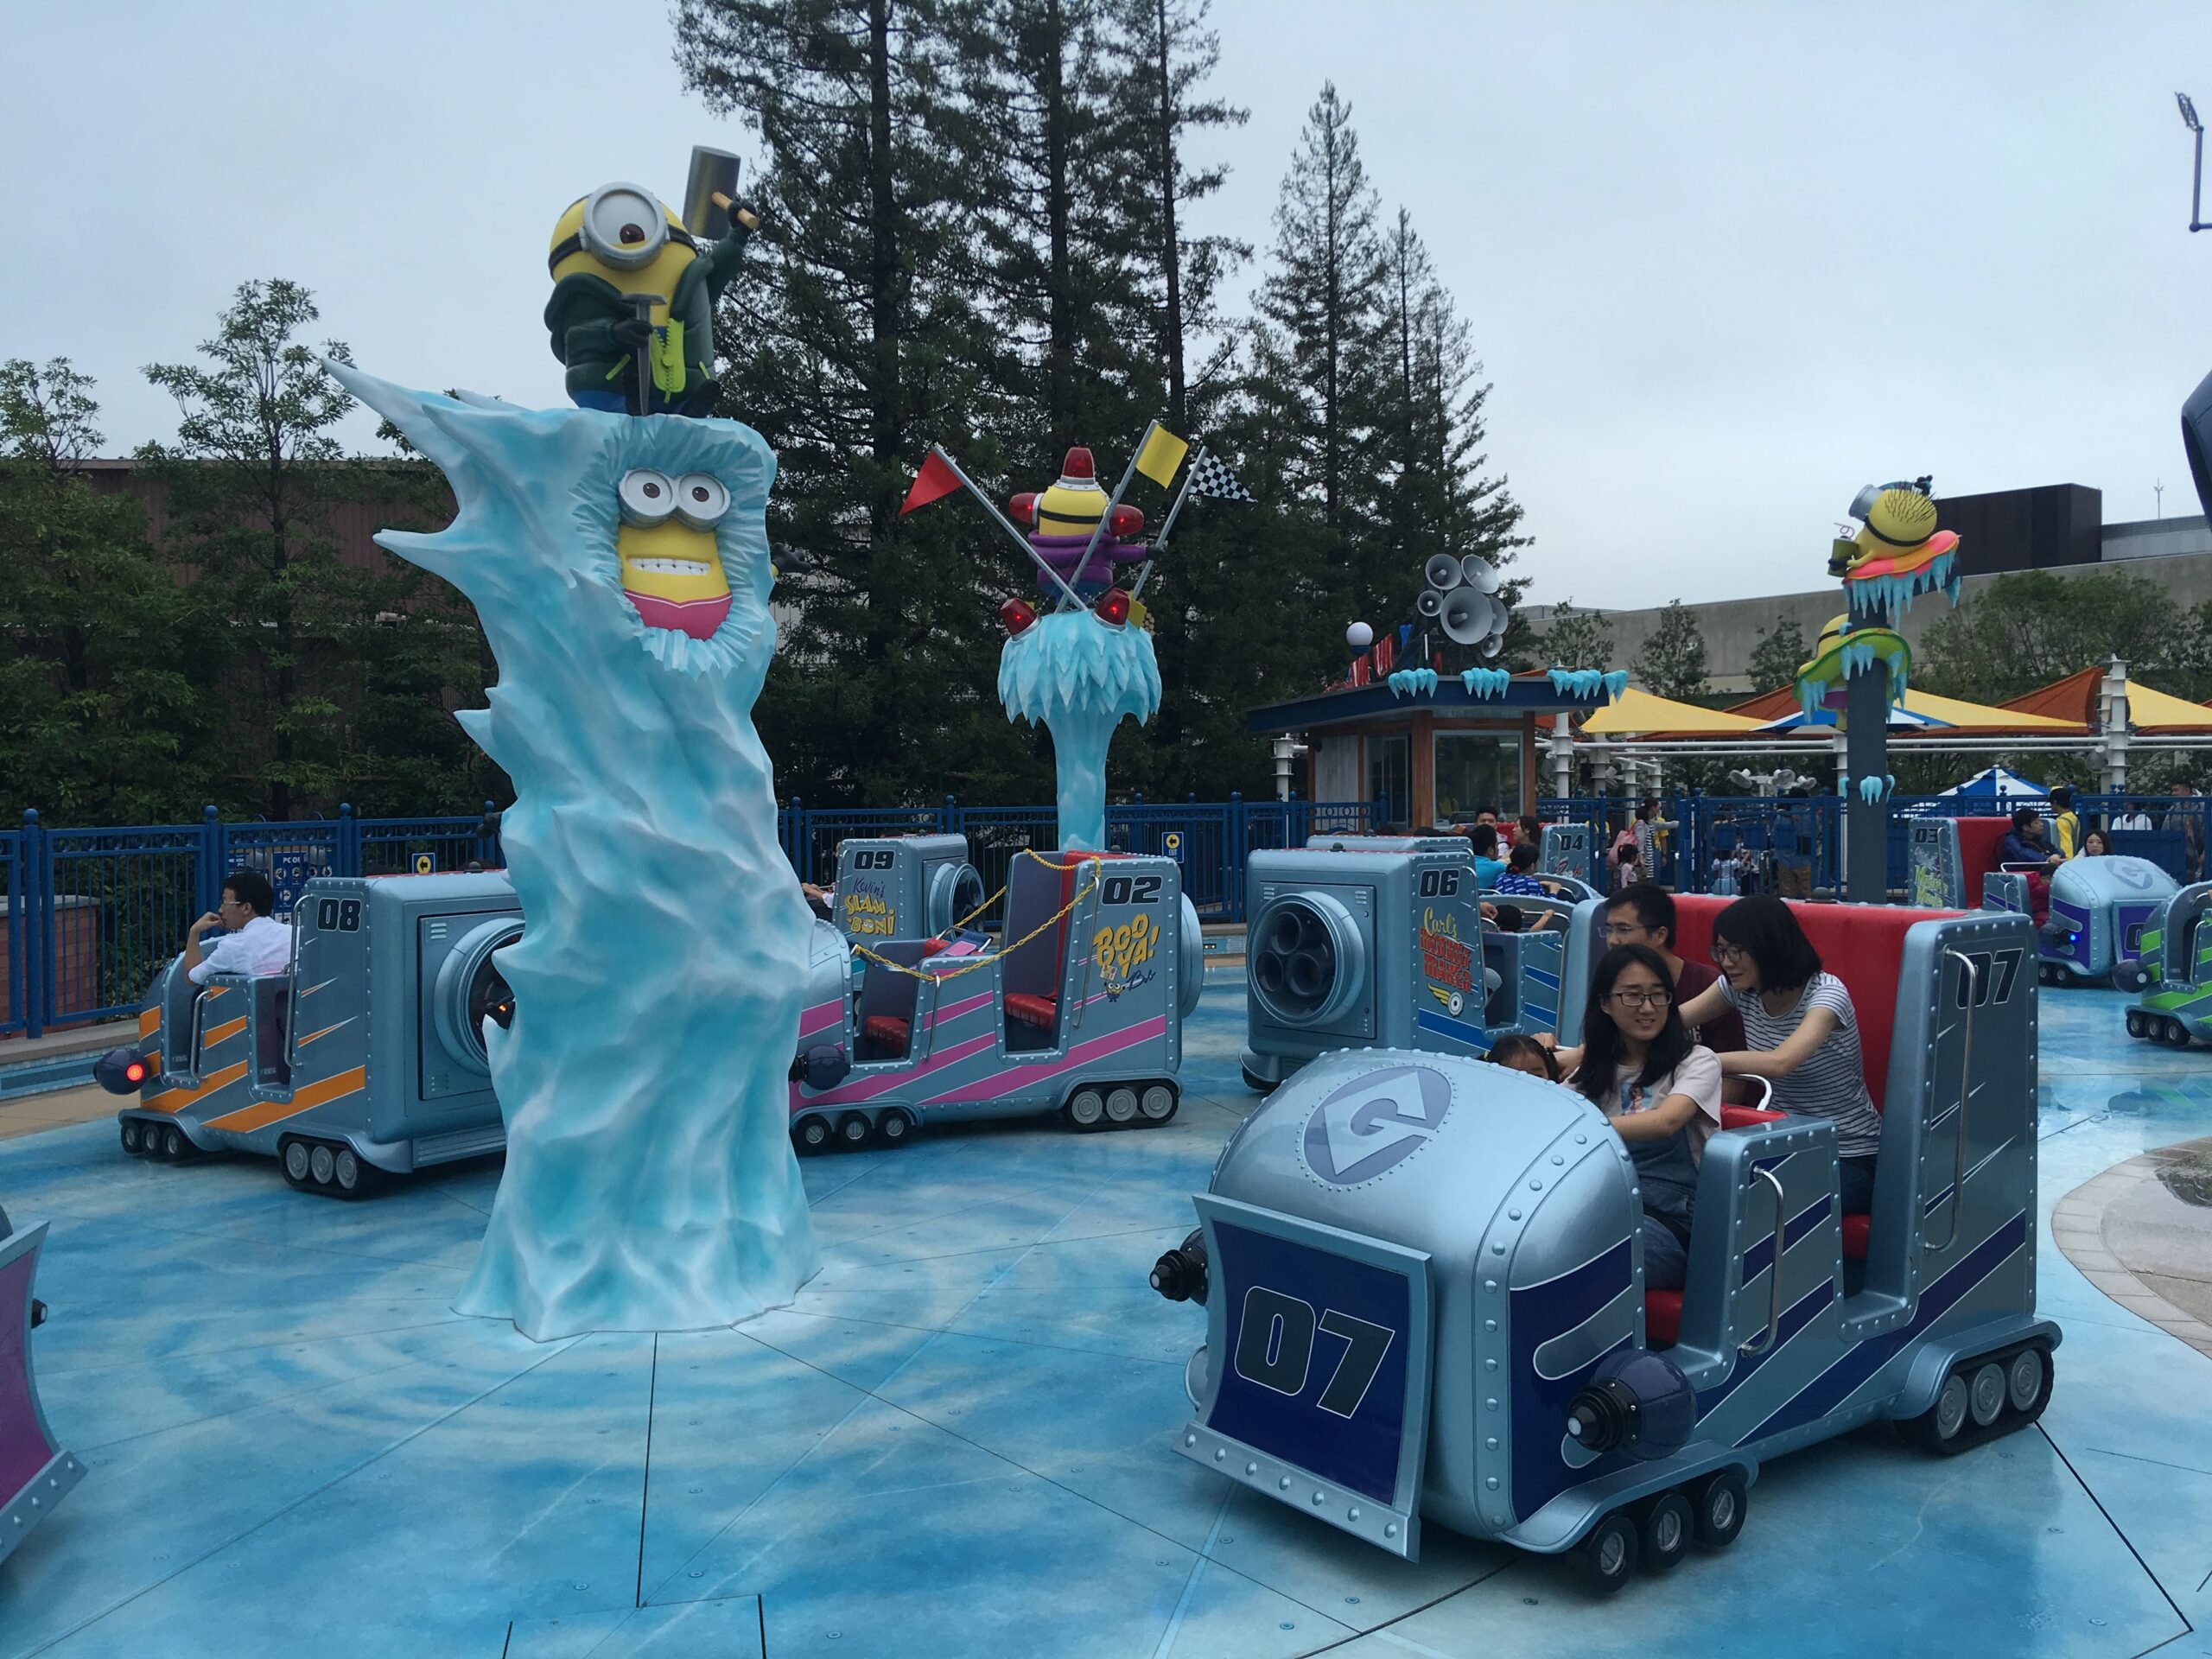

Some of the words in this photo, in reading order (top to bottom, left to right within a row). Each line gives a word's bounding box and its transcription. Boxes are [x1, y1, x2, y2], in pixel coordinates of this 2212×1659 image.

[1559, 834, 1584, 851] 04
[1915, 827, 1939, 844] 03
[853, 849, 895, 871] 09
[853, 877, 886, 898] Kevin's
[1101, 874, 1163, 906] 02
[1419, 868, 1460, 898] 06
[317, 898, 361, 932] 08
[1424, 906, 1458, 938] Carl's
[2125, 922, 2145, 953] 0
[1955, 947, 2024, 1010] 07
[1235, 1285, 1396, 1420] 07
